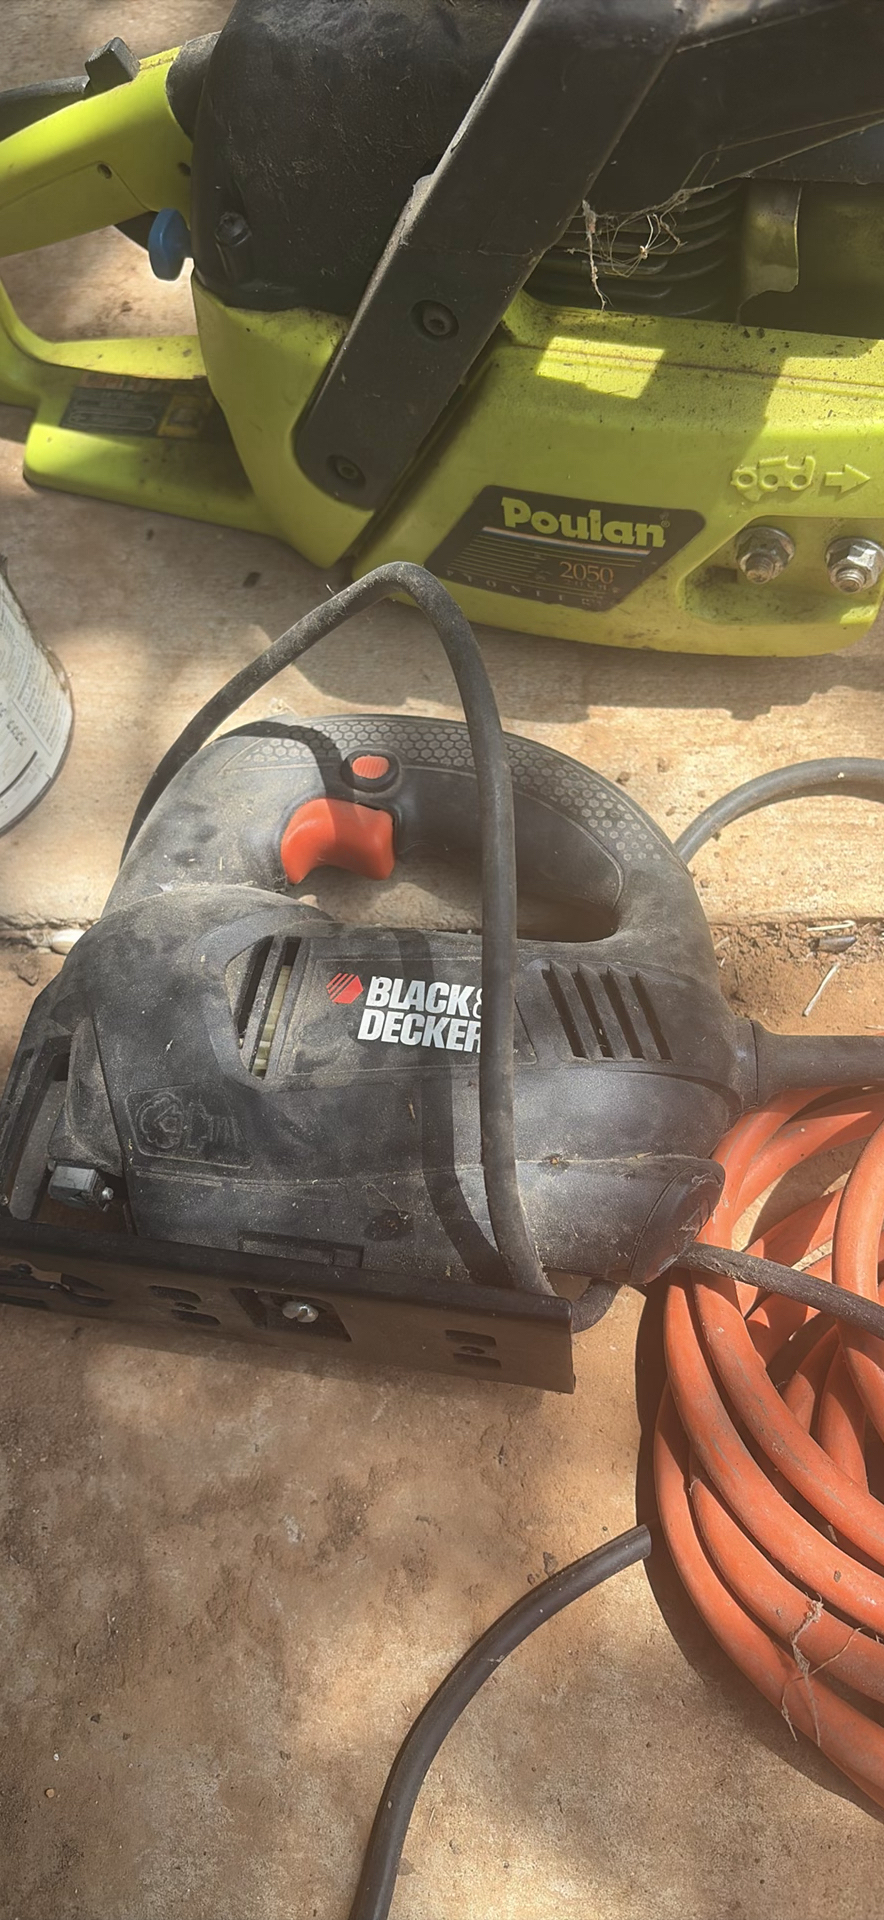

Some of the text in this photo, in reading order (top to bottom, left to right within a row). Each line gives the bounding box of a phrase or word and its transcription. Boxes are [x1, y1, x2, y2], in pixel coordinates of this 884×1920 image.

[501, 496, 666, 548] Poulan
[559, 561, 614, 585] 2050
[357, 1008, 482, 1053] DECKER
